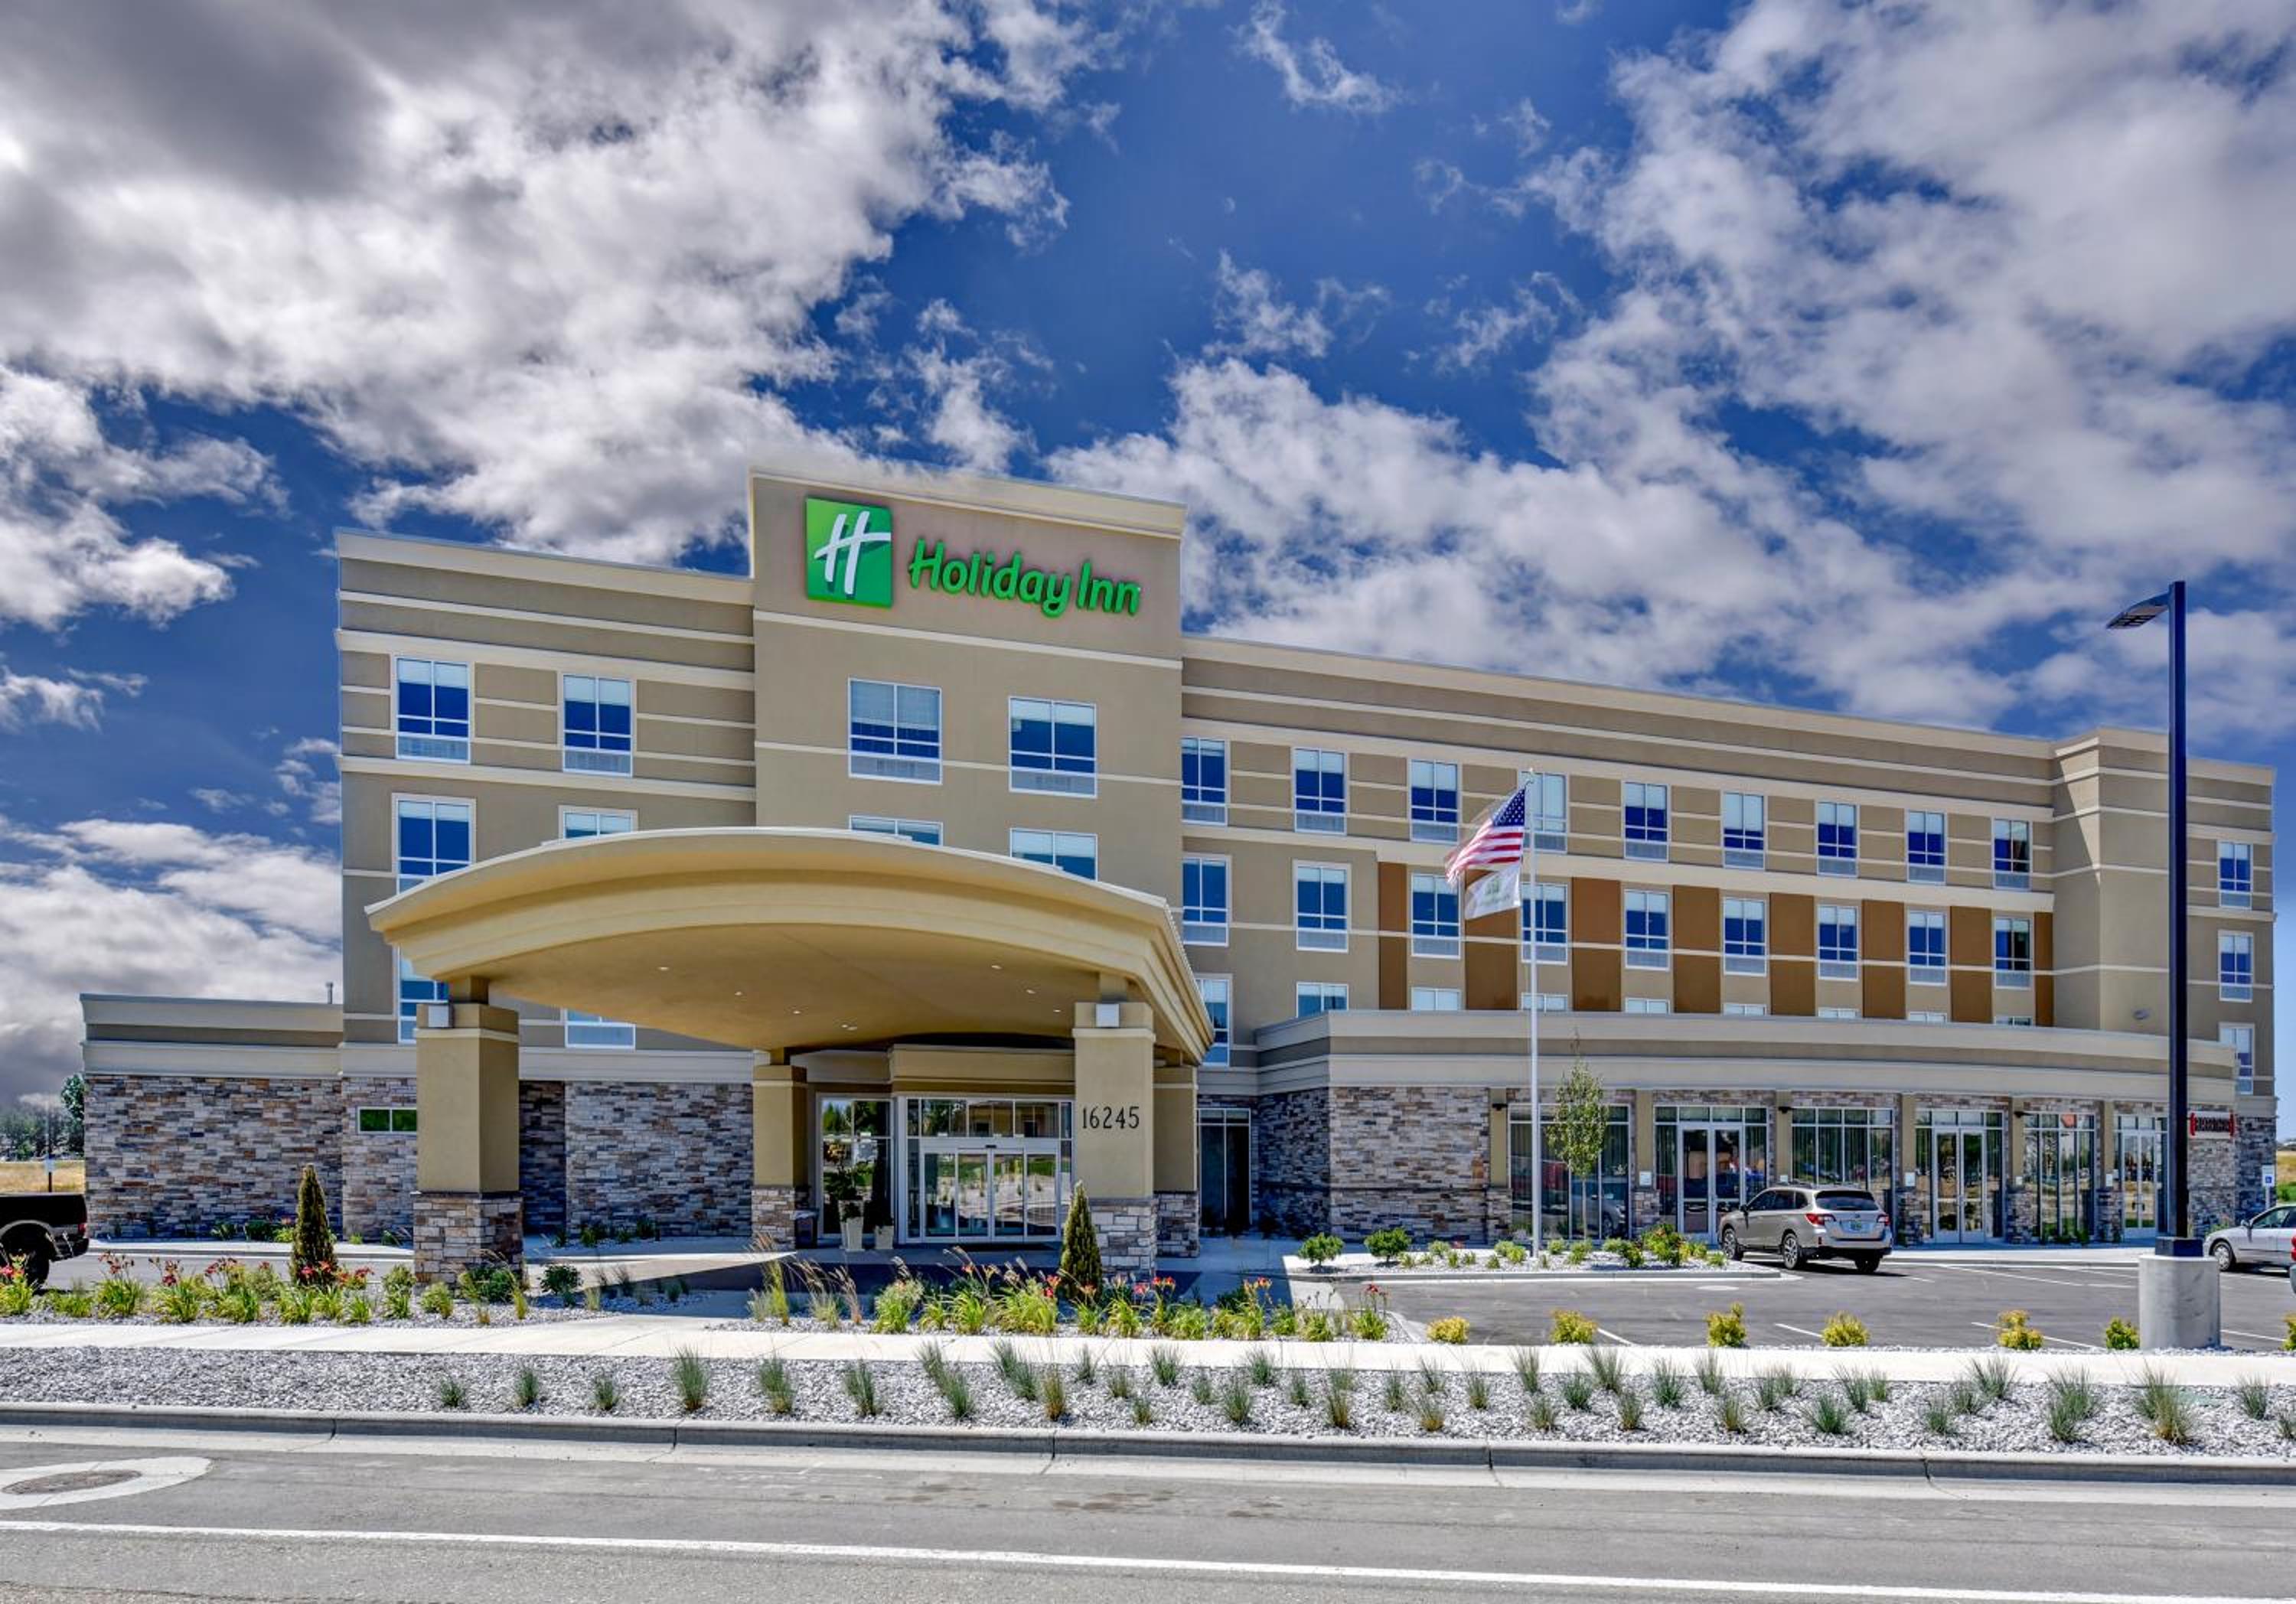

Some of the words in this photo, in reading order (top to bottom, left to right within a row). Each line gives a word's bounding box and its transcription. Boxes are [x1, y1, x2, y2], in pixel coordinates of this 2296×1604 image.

[908, 537, 1071, 618] Holiday
[1076, 560, 1141, 617] Inn
[1082, 1106, 1140, 1129] 16245
